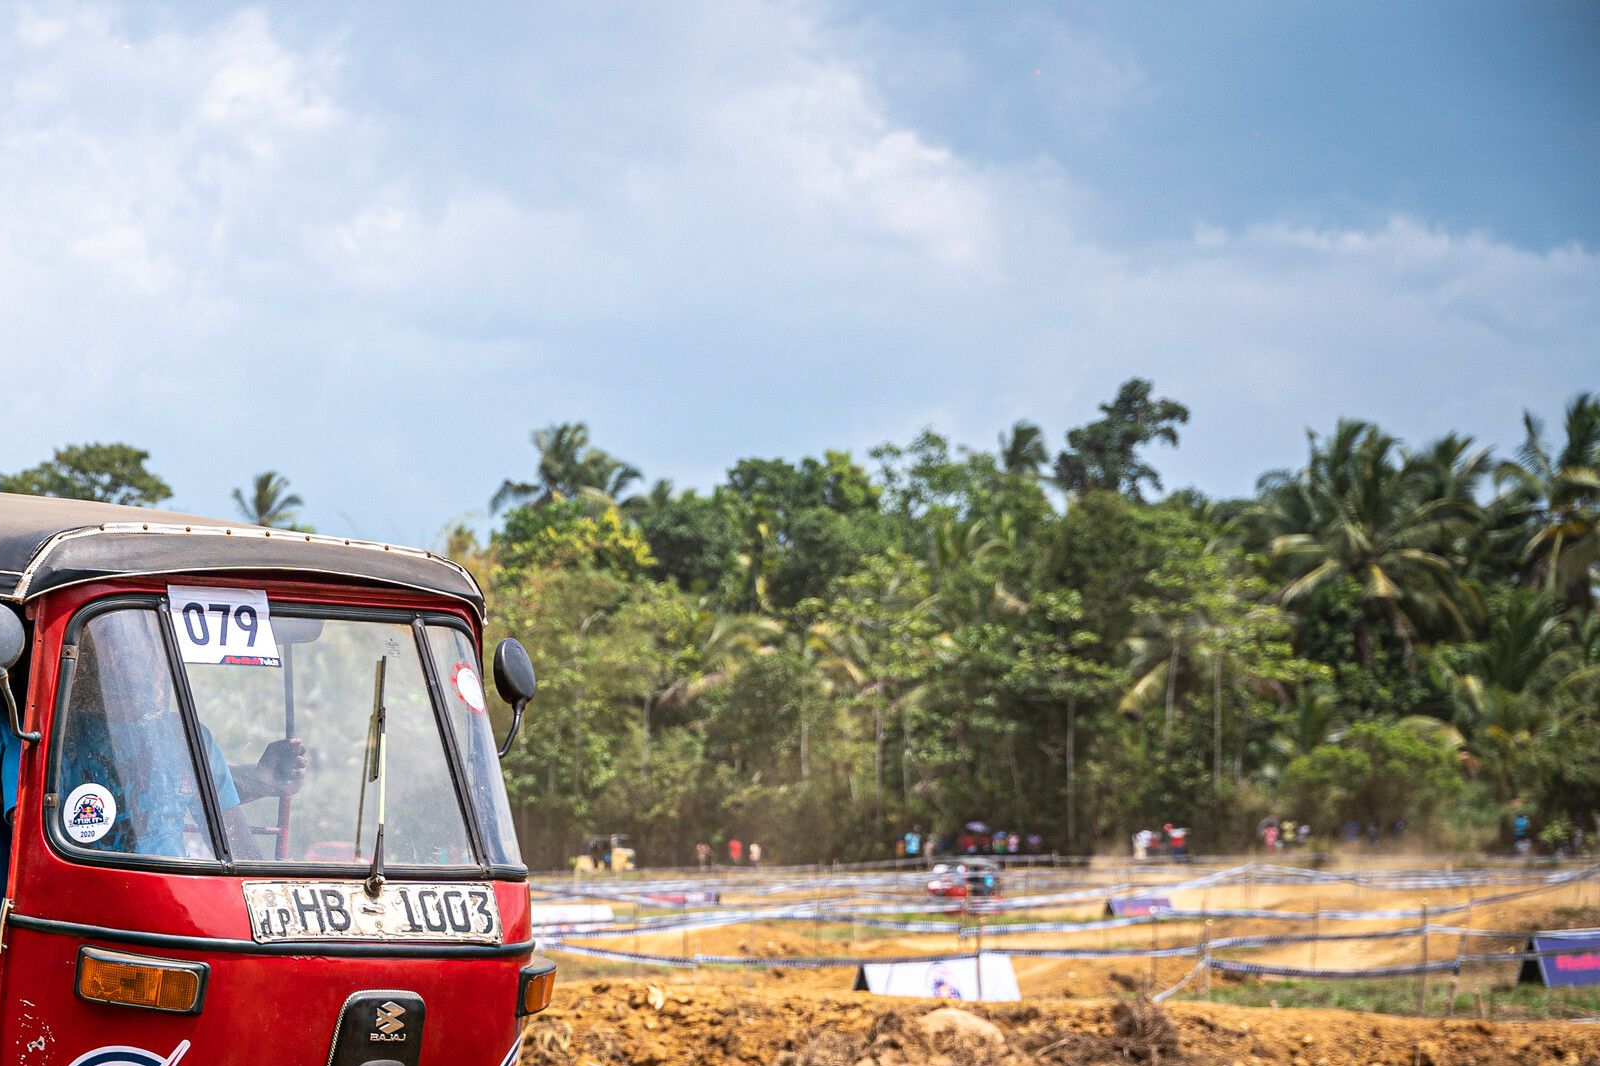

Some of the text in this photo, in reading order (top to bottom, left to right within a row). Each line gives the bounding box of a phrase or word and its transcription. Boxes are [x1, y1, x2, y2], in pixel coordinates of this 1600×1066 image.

[182, 602, 258, 647] 079
[292, 888, 351, 934] HB
[399, 889, 494, 934] 1003
[369, 1032, 407, 1042] BAJAJ
